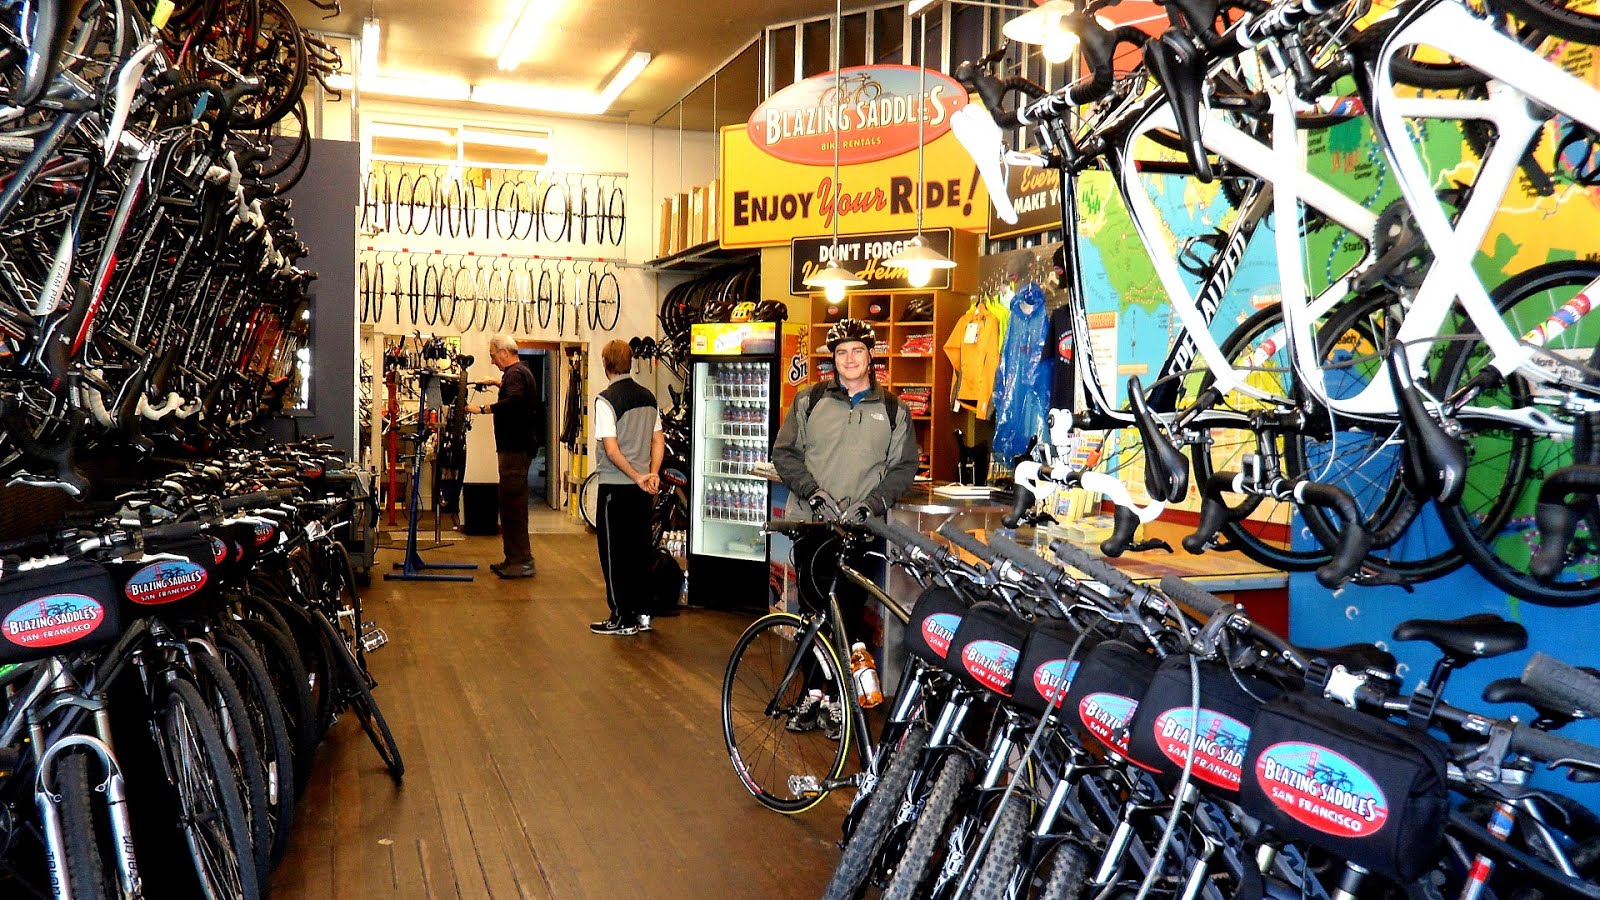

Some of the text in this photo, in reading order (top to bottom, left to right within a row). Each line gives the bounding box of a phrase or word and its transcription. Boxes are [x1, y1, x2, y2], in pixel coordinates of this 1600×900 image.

[765, 85, 946, 145] BLAZING SADDLES
[821, 137, 882, 151] BIK RENTALS
[733, 190, 813, 227] ENJOY
[817, 176, 888, 228] Your
[1013, 190, 1047, 214] MAKE
[819, 240, 912, 262] DON'T FORGE
[53, 260, 68, 287] TEAM
[854, 256, 911, 281] Helm
[131, 570, 202, 596] BLAZING SADDLES
[140, 584, 197, 602] SAN FRANCISCO
[9, 606, 97, 636] BLAZING SADDLES
[21, 623, 91, 643] SAN FRANCISCO
[927, 619, 954, 642] BLAZIN
[930, 636, 943, 648] SAN
[967, 648, 1002, 675] BLAZING
[970, 664, 985, 678] SAN
[1040, 669, 1071, 692] BLZI
[1085, 700, 1130, 738] BLAZIN
[1090, 721, 1108, 737] SAN
[1167, 743, 1241, 783] SAN FRANCIS
[1264, 757, 1377, 822] BLAZING SADDLES
[1272, 786, 1363, 832] SAN FRANCISCO
